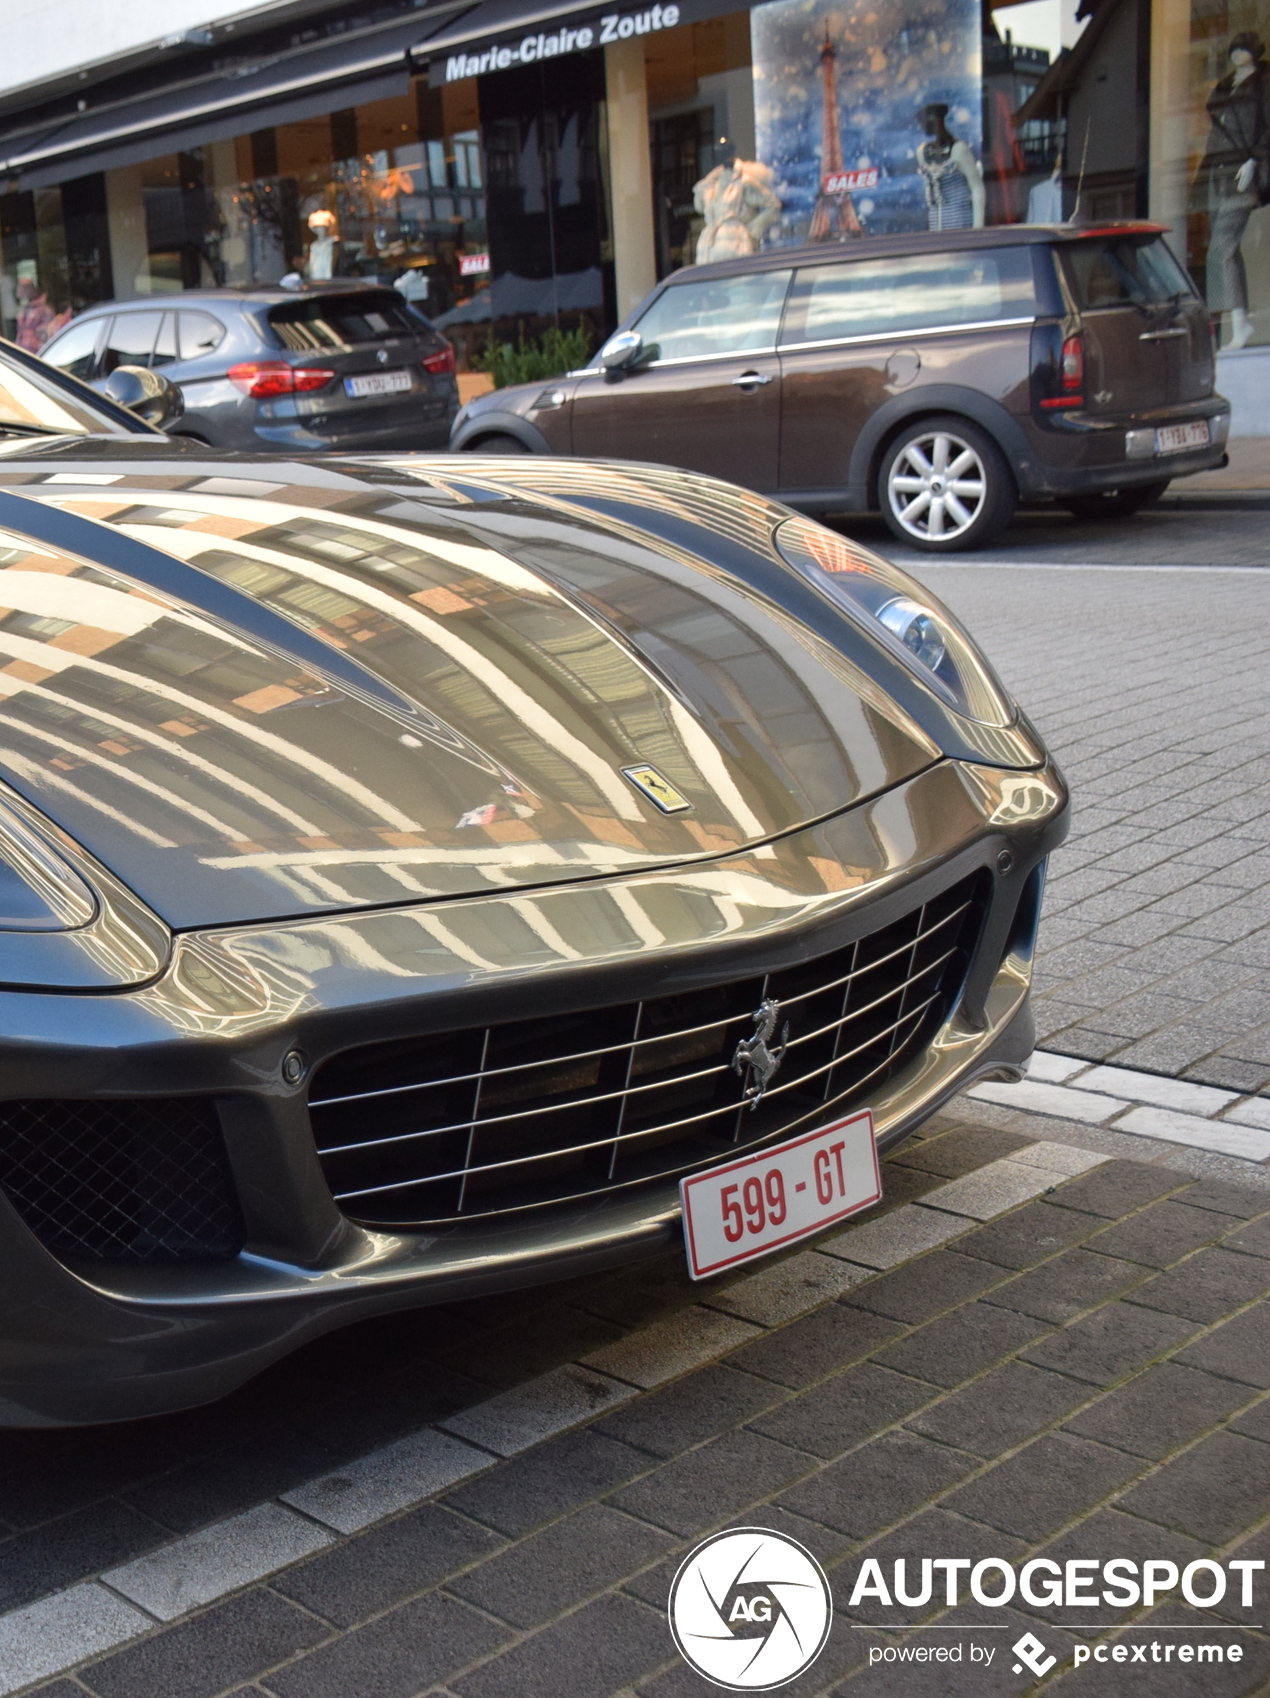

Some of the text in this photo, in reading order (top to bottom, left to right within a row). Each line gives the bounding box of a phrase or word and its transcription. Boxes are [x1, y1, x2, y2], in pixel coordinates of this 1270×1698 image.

[445, 3, 680, 82] Marie-Claire Zoute
[827, 170, 878, 192] SALES
